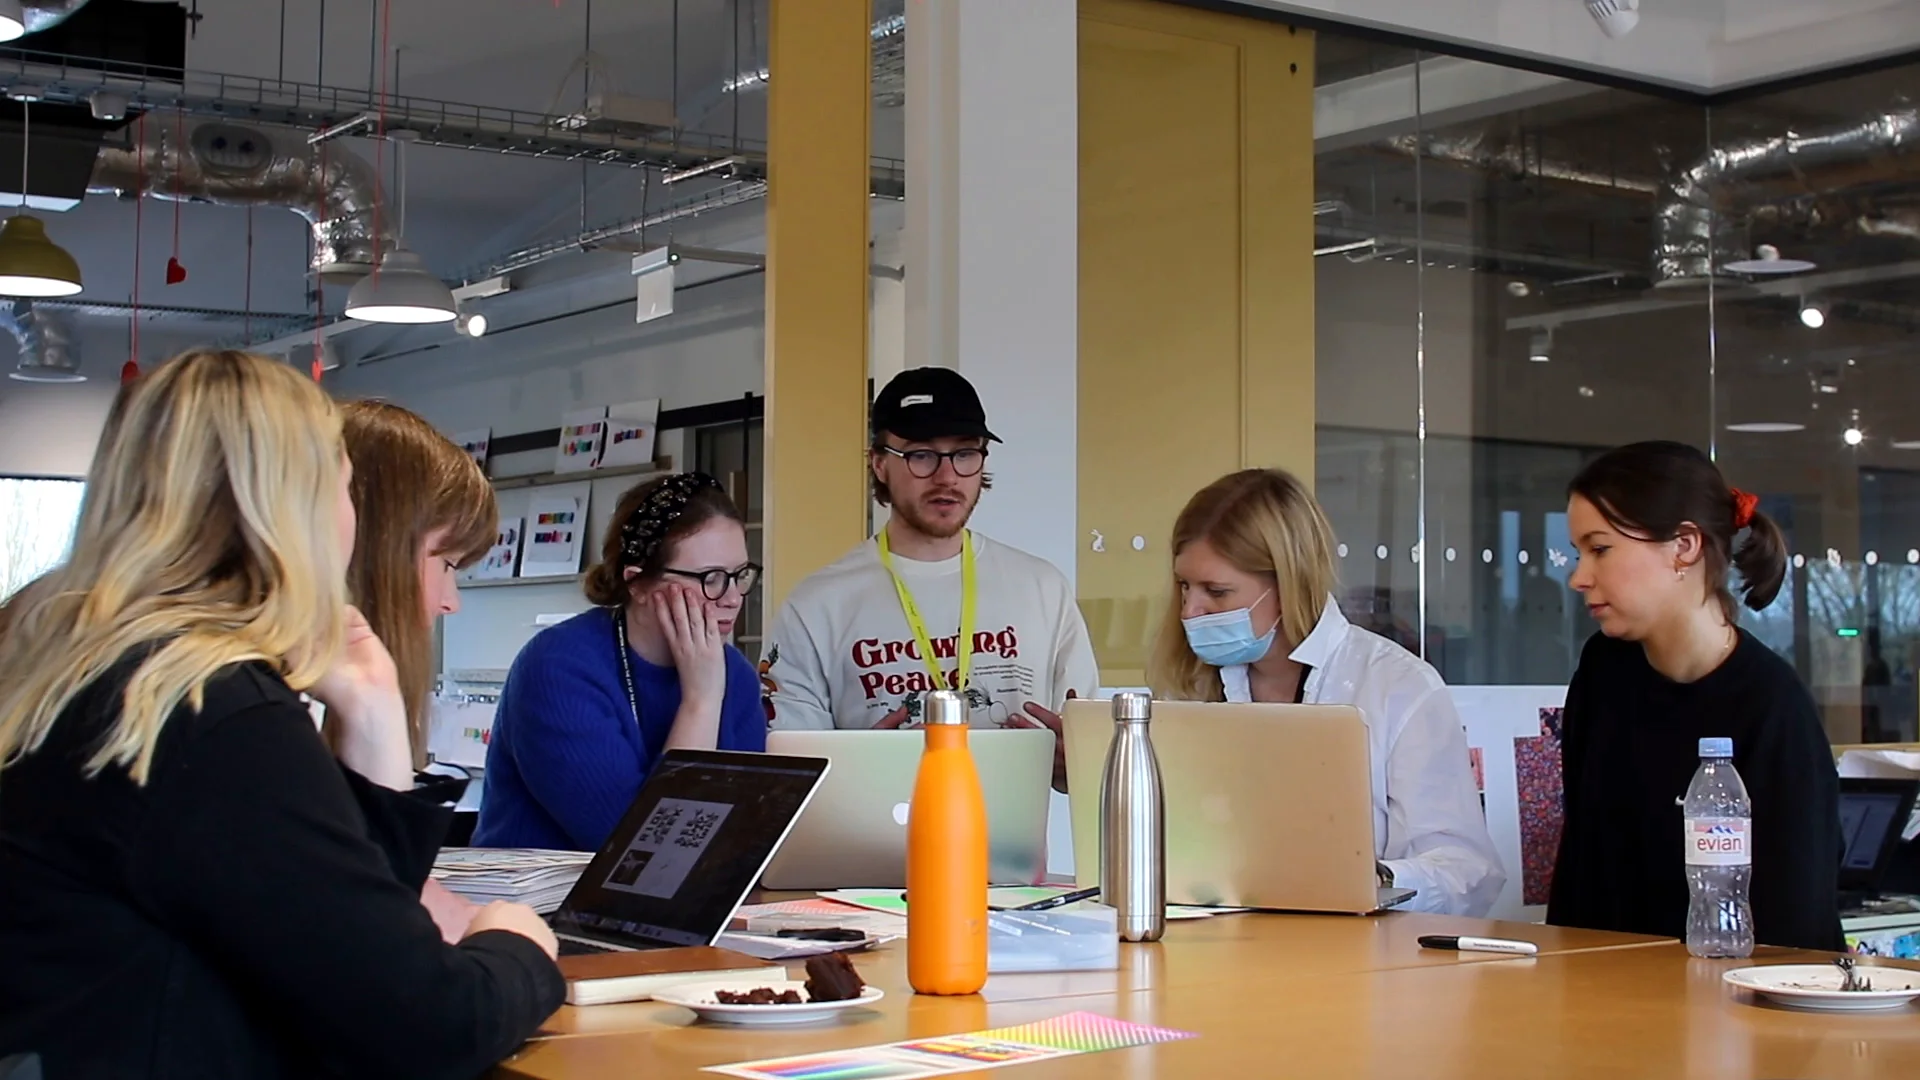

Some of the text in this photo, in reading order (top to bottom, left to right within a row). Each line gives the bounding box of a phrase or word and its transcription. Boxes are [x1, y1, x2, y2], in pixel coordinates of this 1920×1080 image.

[852, 626, 1018, 668] Growng
[859, 668, 970, 700] Peace
[1697, 836, 1742, 851] evian
